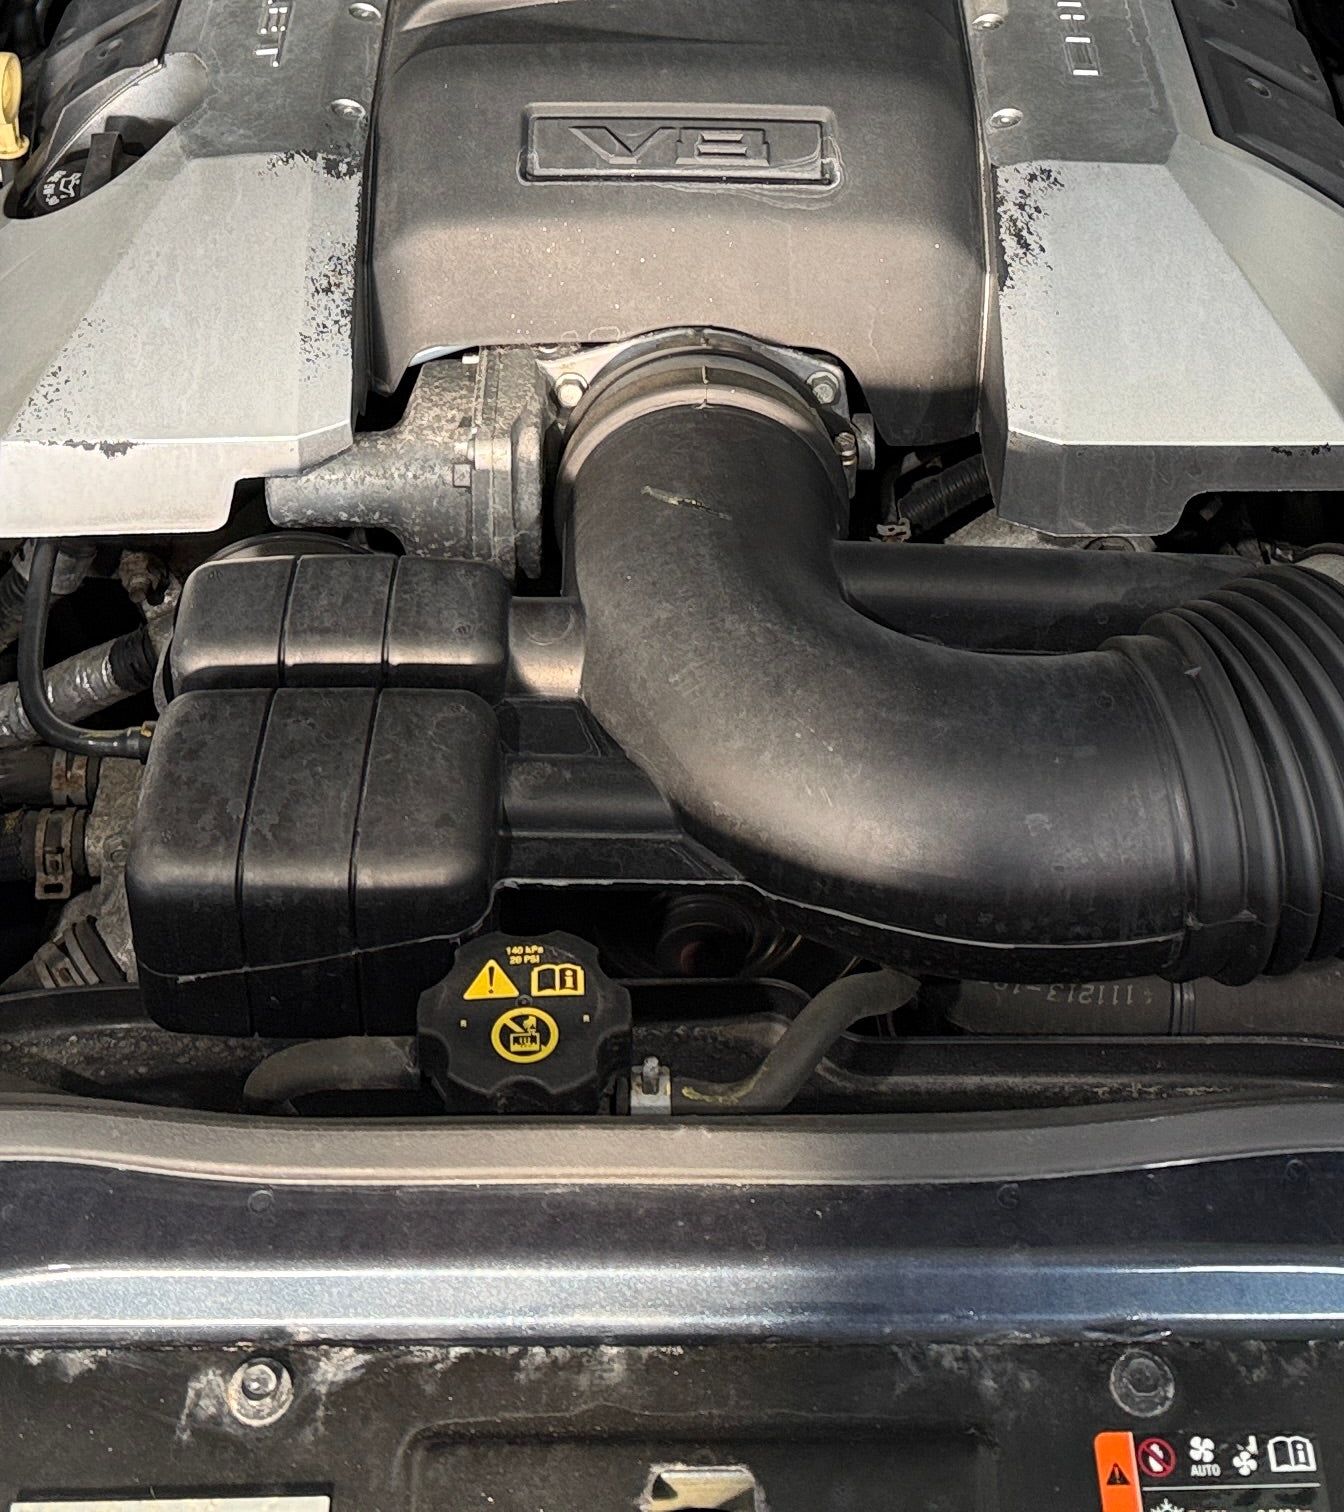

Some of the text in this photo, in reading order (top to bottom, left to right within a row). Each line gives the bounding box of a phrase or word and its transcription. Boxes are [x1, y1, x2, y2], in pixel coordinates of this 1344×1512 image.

[568, 125, 770, 166] V8
[506, 945, 544, 955] 140 kPa
[509, 955, 540, 965] 20 PSI
[1190, 1463, 1220, 1477] AUTO
